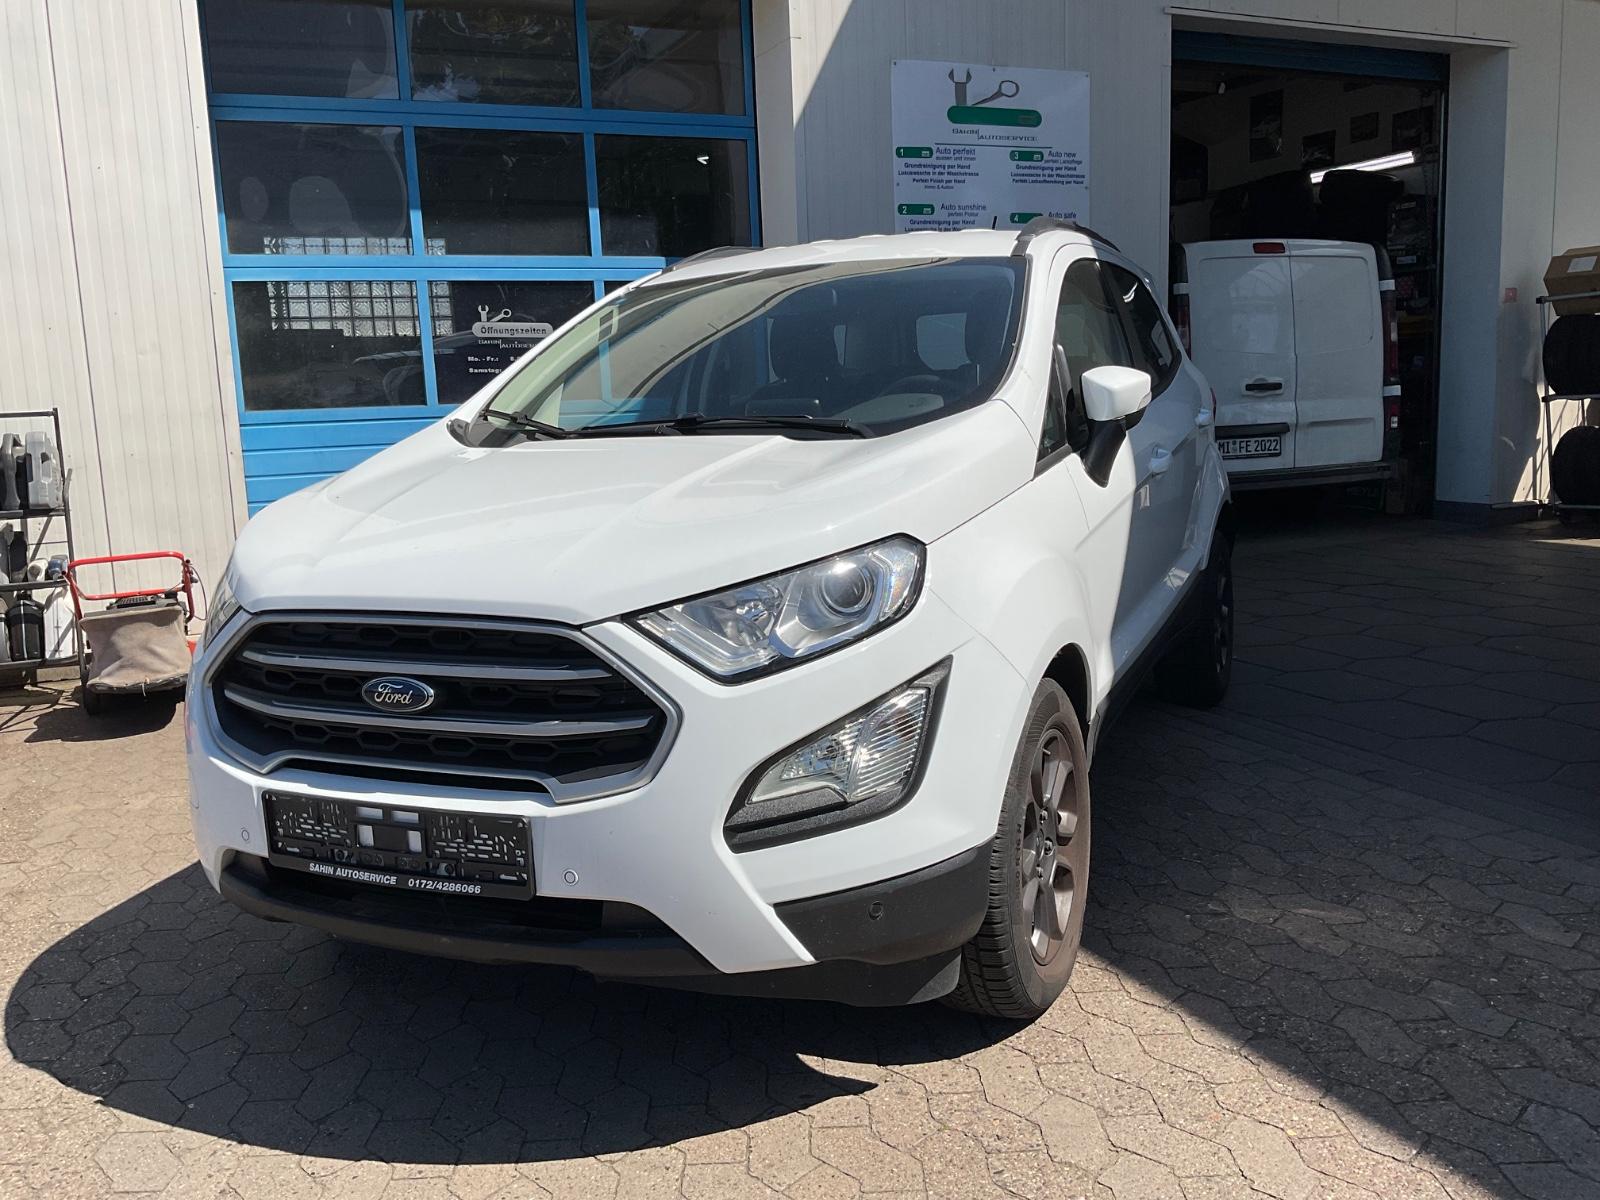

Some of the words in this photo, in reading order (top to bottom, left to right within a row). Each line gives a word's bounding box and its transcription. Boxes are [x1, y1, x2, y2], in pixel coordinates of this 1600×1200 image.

[481, 326, 546, 336] Öffnungszeiten
[1218, 441, 1230, 454] MI
[1239, 440, 1251, 453] FE
[1254, 438, 1278, 452] 2022
[374, 682, 413, 704] Ford
[310, 862, 334, 875] SAHIN
[336, 866, 397, 885] AUTOSERVICE
[408, 878, 481, 894] 0172/4286066
